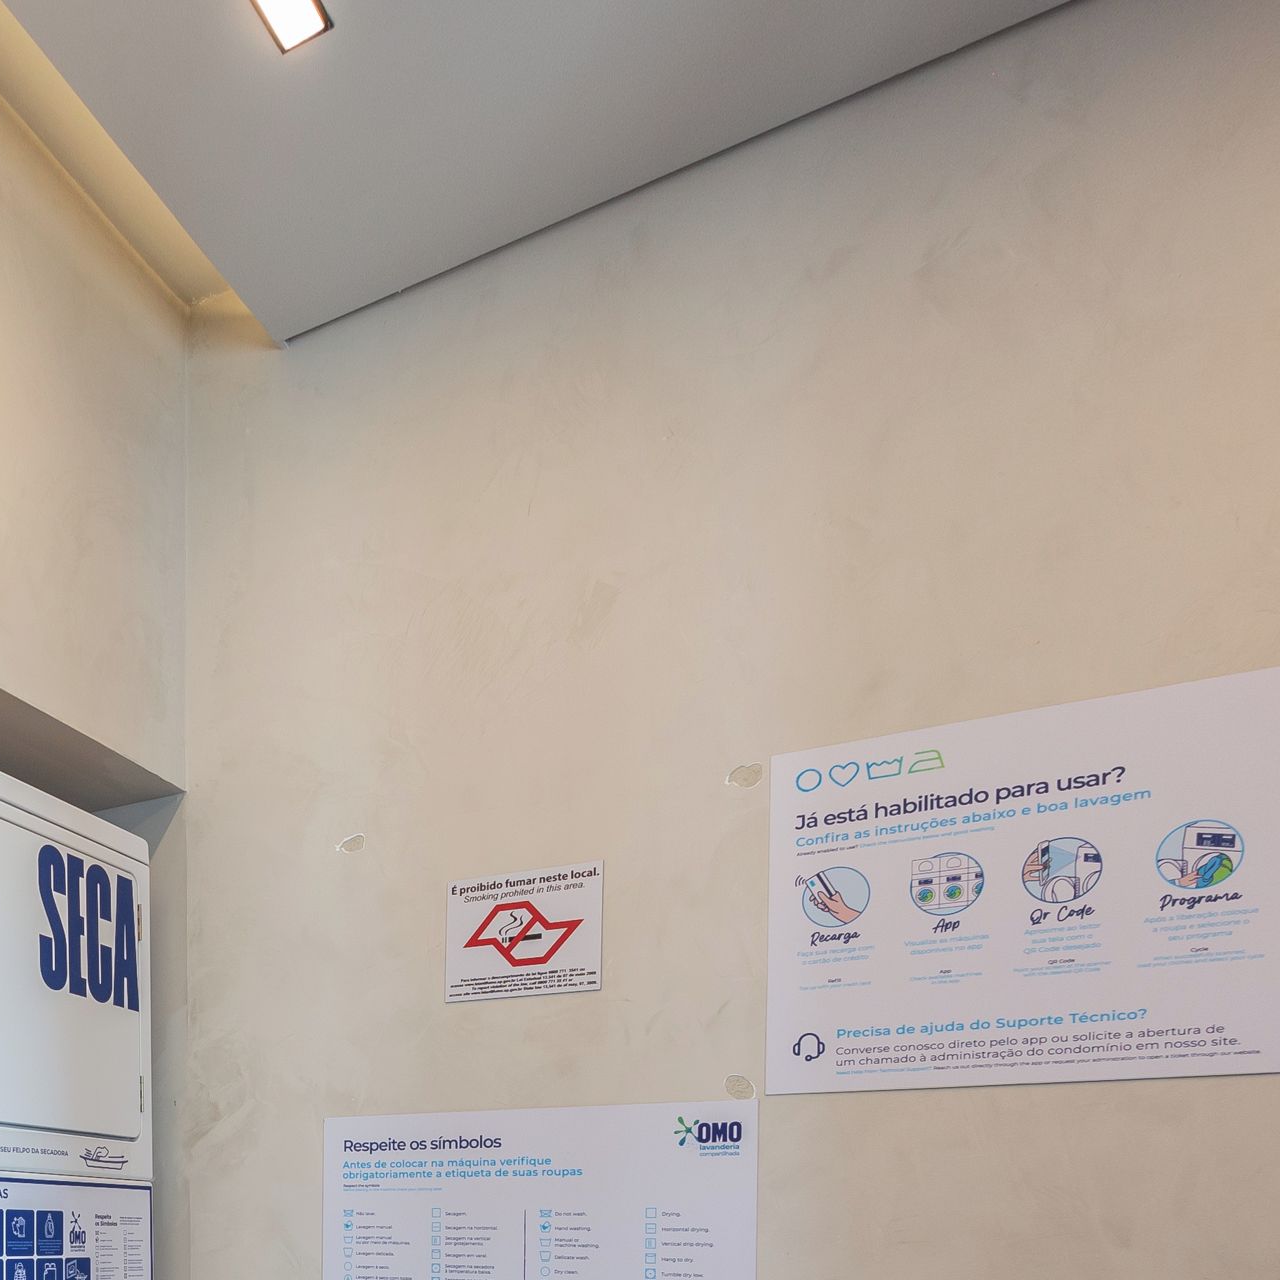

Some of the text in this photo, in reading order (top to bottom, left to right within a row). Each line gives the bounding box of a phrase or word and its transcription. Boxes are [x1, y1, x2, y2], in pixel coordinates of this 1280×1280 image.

[795, 766, 1126, 830] Já está habilitado para usar?
[796, 832, 849, 847] Confira
[854, 830, 870, 839] as
[875, 817, 957, 836] instruções
[962, 808, 1016, 824] abaixo
[1021, 807, 1031, 815] e
[1037, 801, 1068, 814] boa
[1074, 790, 1151, 808] lavagem
[451, 867, 600, 896] É proibido fumar neste local.
[463, 882, 585, 904] Smoking prohited in this area.
[1160, 892, 1243, 911] Programa
[1057, 904, 1095, 922] Code
[38, 845, 140, 1012] SECA
[932, 918, 960, 934] App
[810, 931, 861, 946] Recarga
[837, 1008, 1147, 1039] Precisa de ajuda do Suporte Técnico?
[836, 1024, 1225, 1055] Converse conosco direto pelo app ou solicite a abertura de
[858, 1054, 916, 1065] chamado
[919, 1053, 927, 1062] à
[930, 1047, 1023, 1062] administração
[1026, 1044, 1044, 1056] do
[1047, 1042, 1132, 1055] condomínio
[1135, 1042, 1159, 1051] em
[1164, 1040, 1207, 1049] nosso
[1211, 1037, 1240, 1046] site.
[698, 1121, 742, 1143] OMO
[344, 1135, 502, 1155] Respeite os símbolos
[343, 1161, 373, 1169] Antes
[374, 1160, 387, 1168] de
[390, 1159, 428, 1168] colocar
[447, 1157, 496, 1170] máquina
[499, 1156, 551, 1169] verifique
[343, 1170, 433, 1181] obrigatoriamente
[445, 1167, 491, 1179] etiqueta
[494, 1168, 509, 1177] de
[512, 1169, 538, 1177] suas
[542, 1169, 583, 1178] roupas
[70, 1230, 86, 1244] OMO
